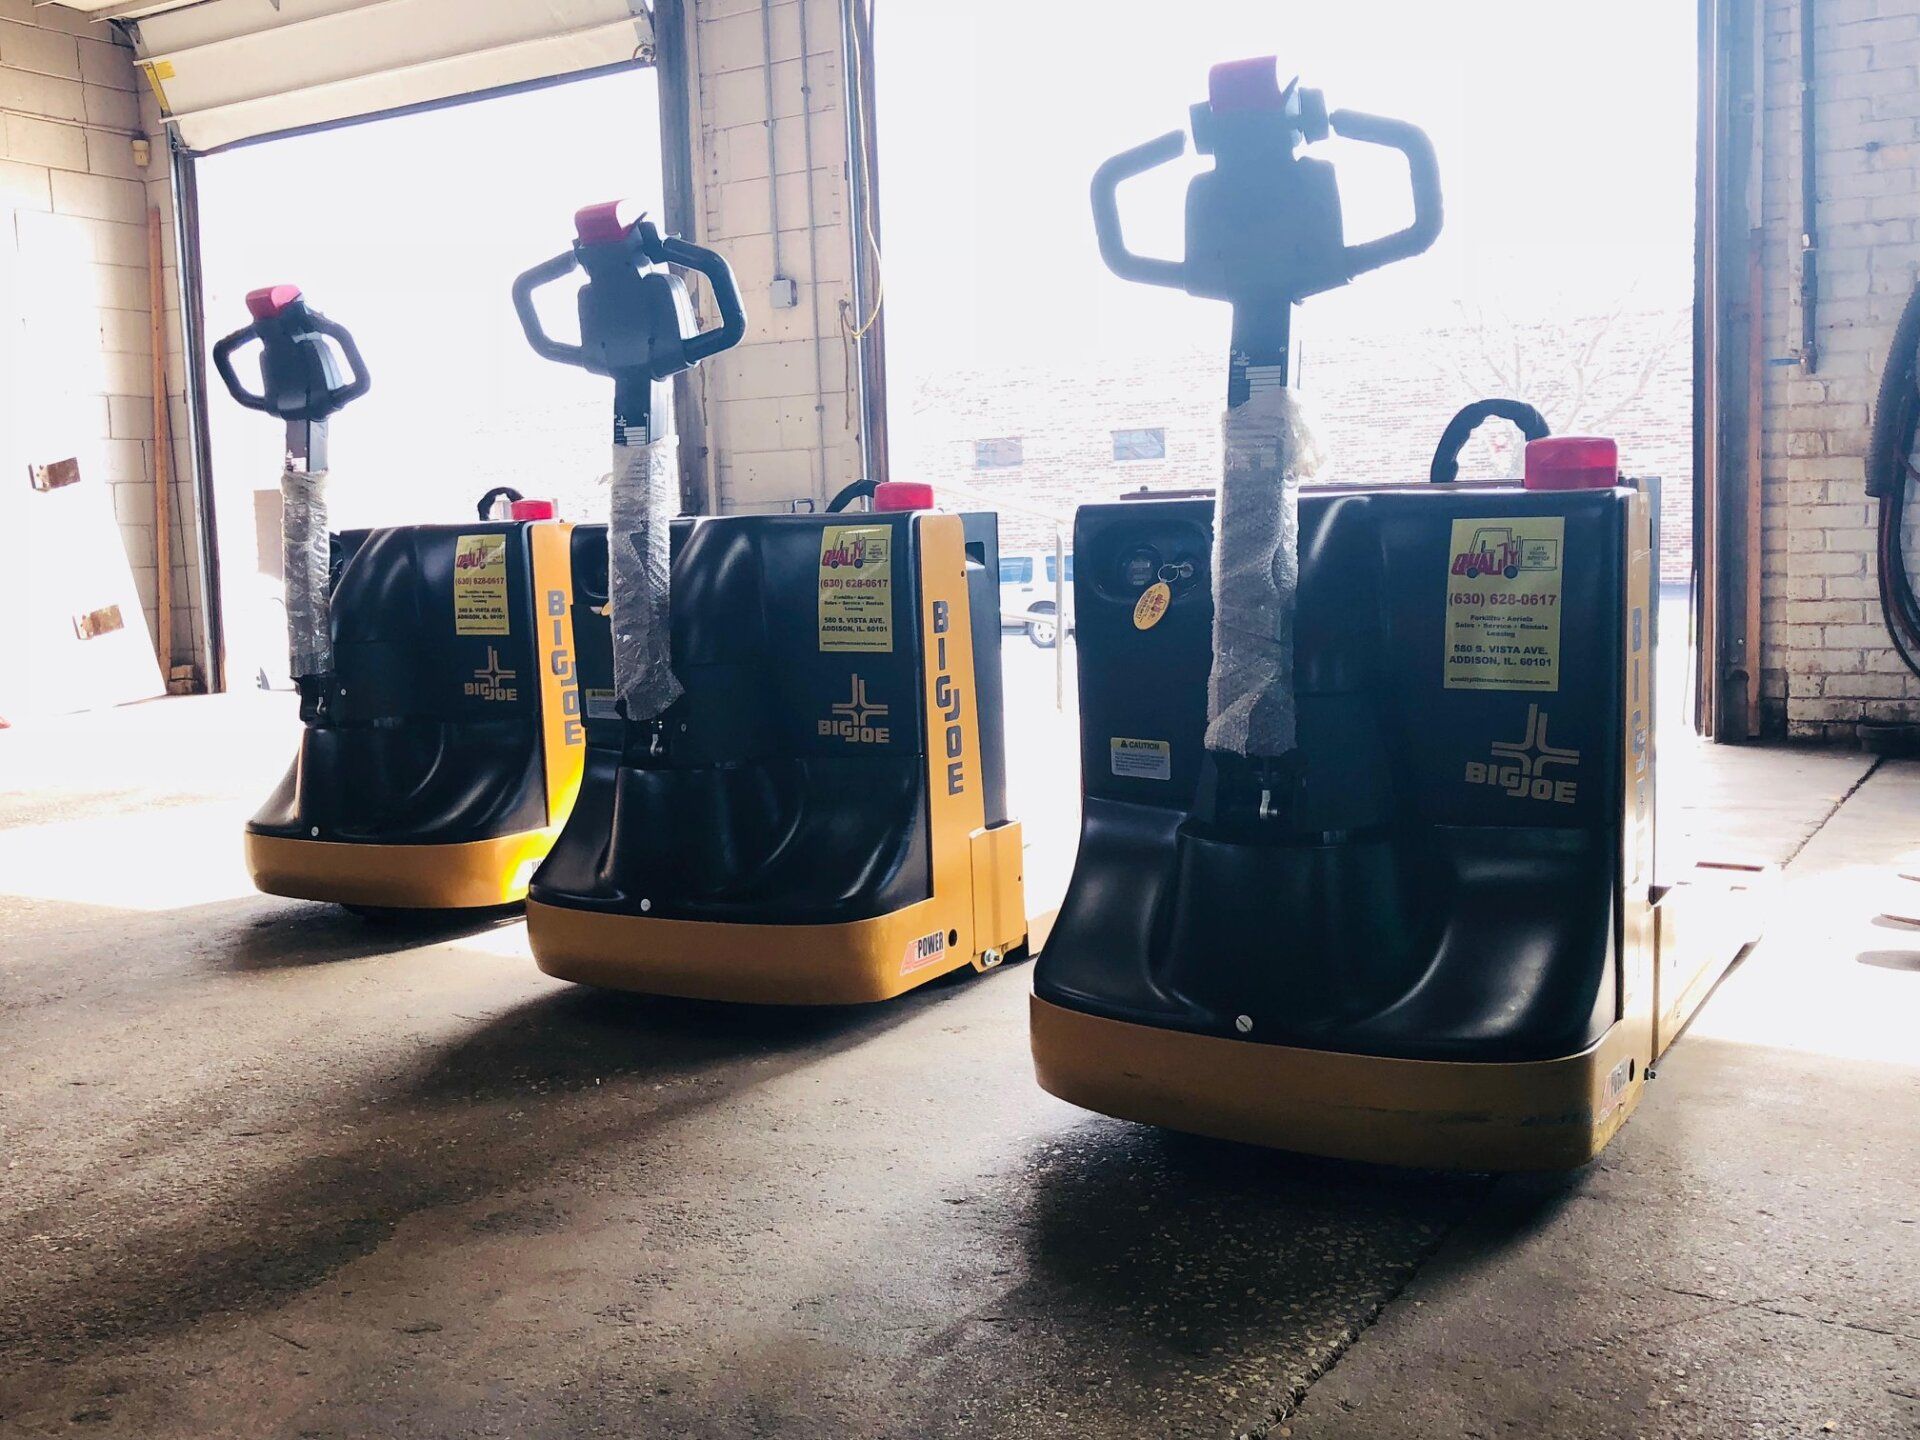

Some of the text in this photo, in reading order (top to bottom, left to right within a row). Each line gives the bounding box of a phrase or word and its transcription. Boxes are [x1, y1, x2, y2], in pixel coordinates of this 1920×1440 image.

[820, 579, 888, 589] (630) 628-0617
[1450, 593, 1557, 607] (630) 628-0617
[1453, 644, 1548, 655] 580 S. VISTA AVE.
[1449, 656, 1552, 667] ADDISON, IL. 60101
[1129, 741, 1160, 750] CAUTION
[917, 931, 944, 959] POWER
